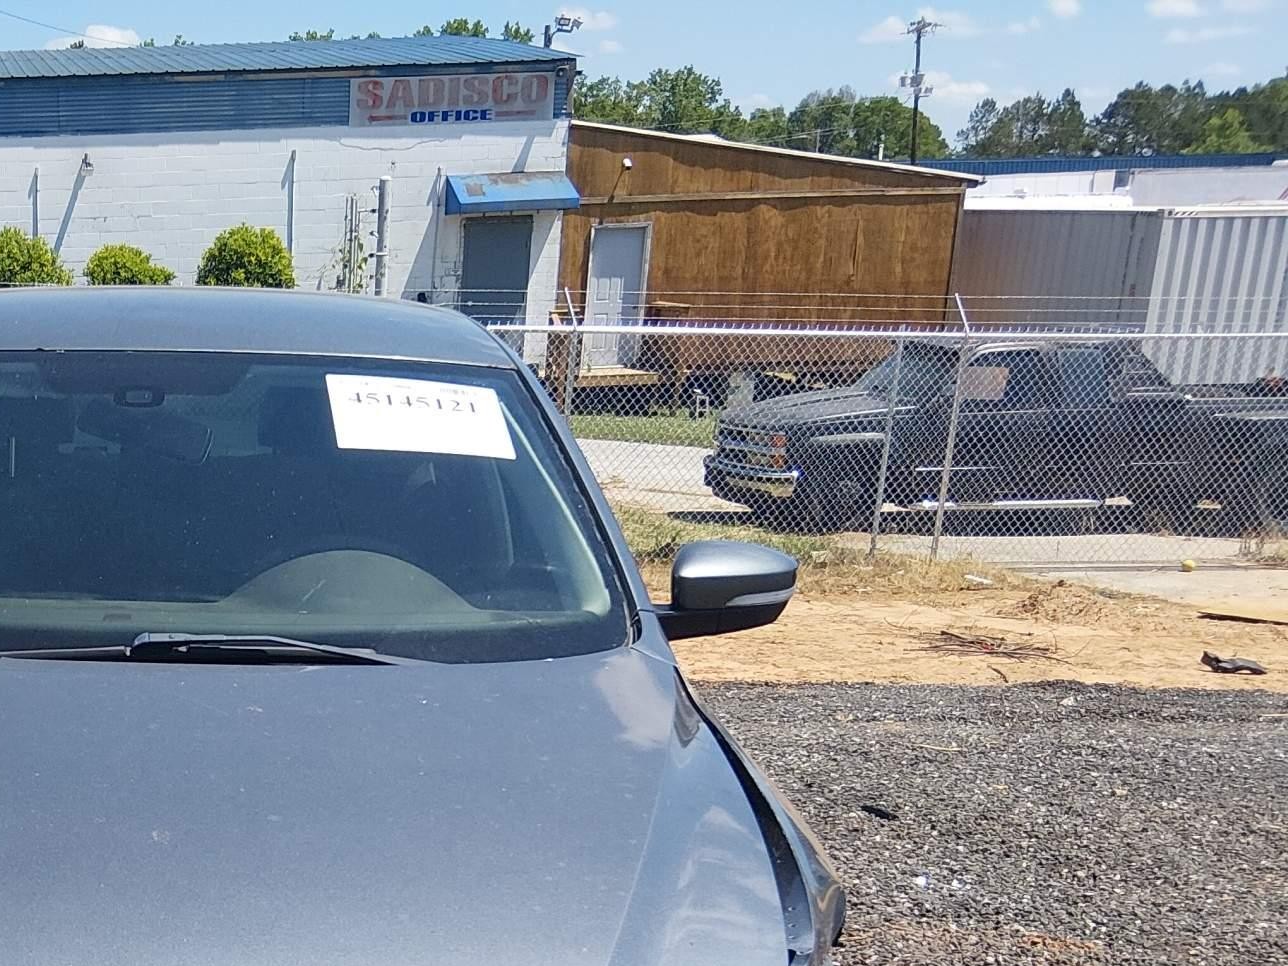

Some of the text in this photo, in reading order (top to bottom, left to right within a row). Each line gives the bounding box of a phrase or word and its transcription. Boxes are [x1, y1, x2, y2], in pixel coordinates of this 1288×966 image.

[356, 74, 549, 111] SADISCO
[410, 108, 493, 123] OFFICE
[348, 392, 476, 413] 45145121
